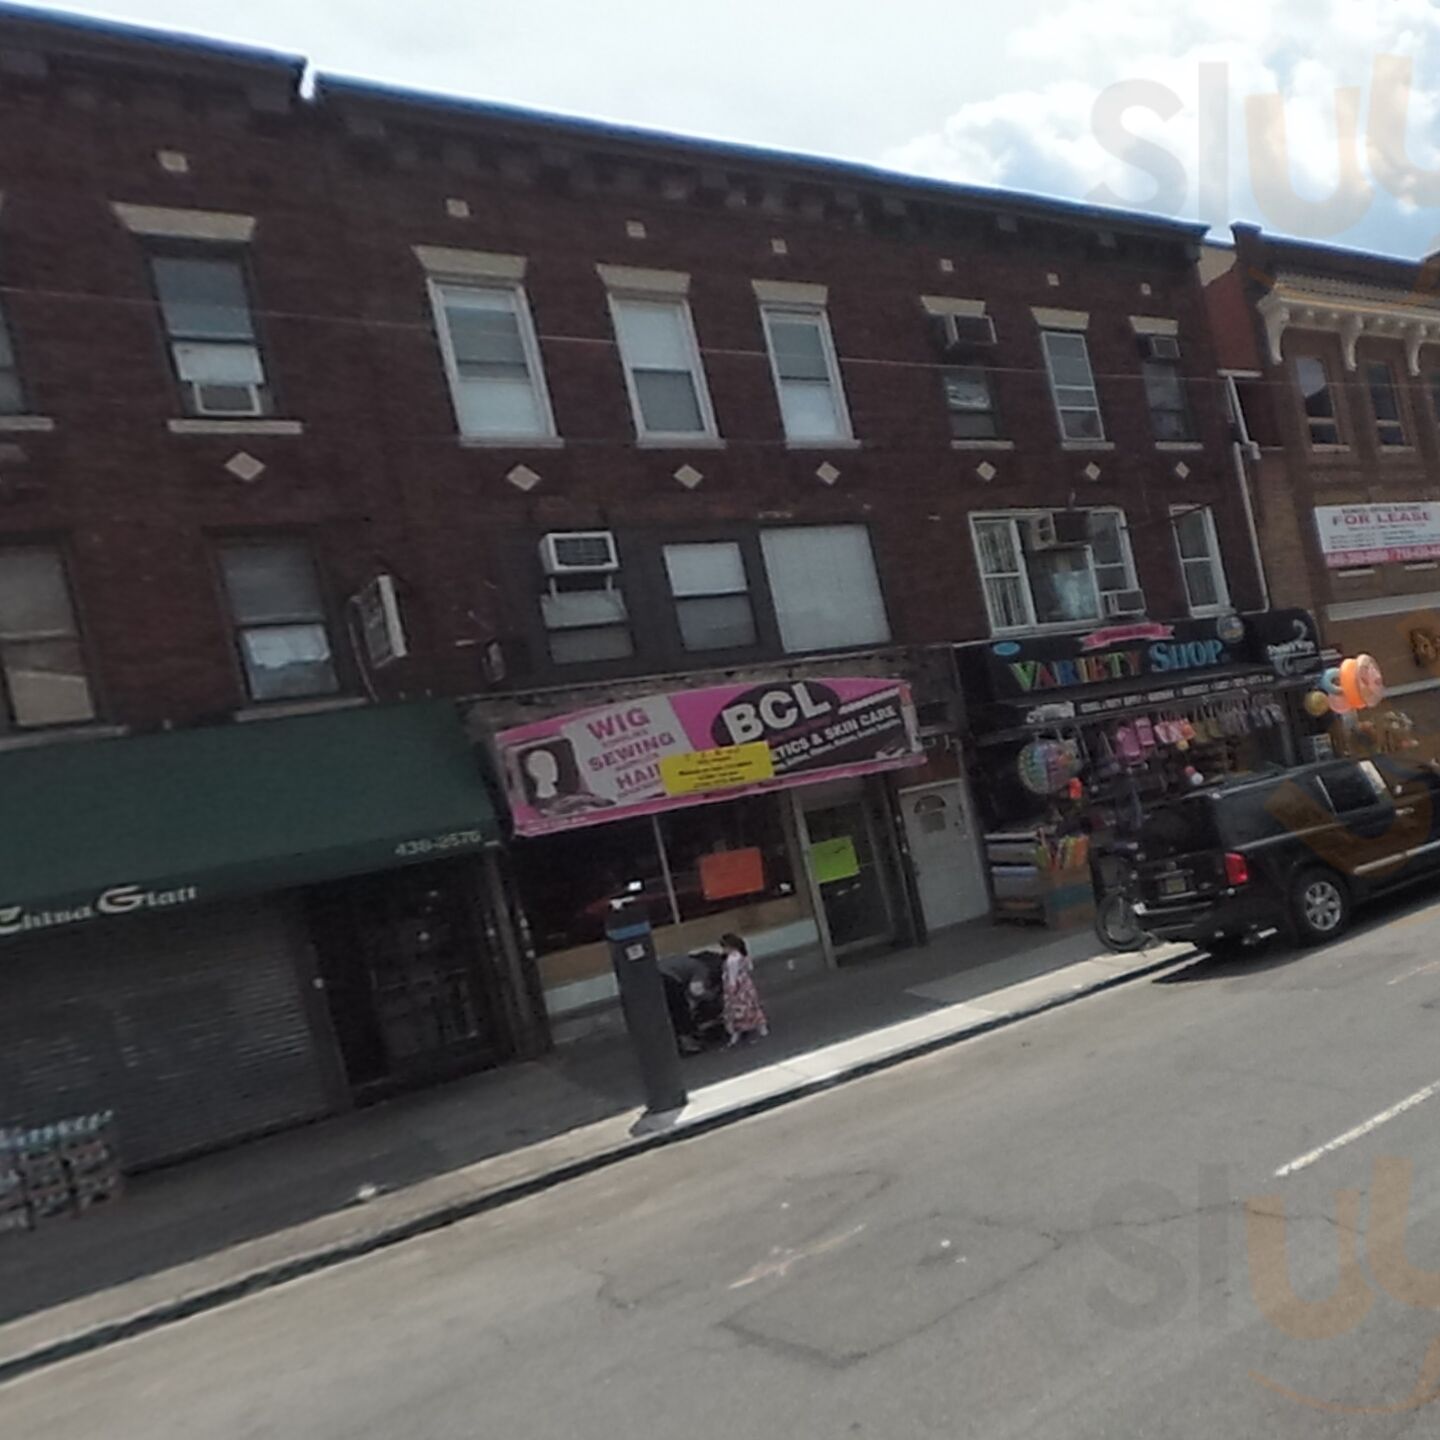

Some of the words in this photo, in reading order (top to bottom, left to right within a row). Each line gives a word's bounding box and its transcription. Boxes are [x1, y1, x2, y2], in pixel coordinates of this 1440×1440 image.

[1332, 513, 1370, 526] FOR
[1377, 511, 1431, 523] LEASE
[1009, 652, 1143, 692] VARIETY
[1150, 639, 1223, 673] SHOP
[586, 707, 651, 740] WIG
[722, 682, 832, 745] BCL
[824, 717, 859, 740] SKIN
[859, 704, 898, 725] CARE
[588, 731, 676, 772] SEWING
